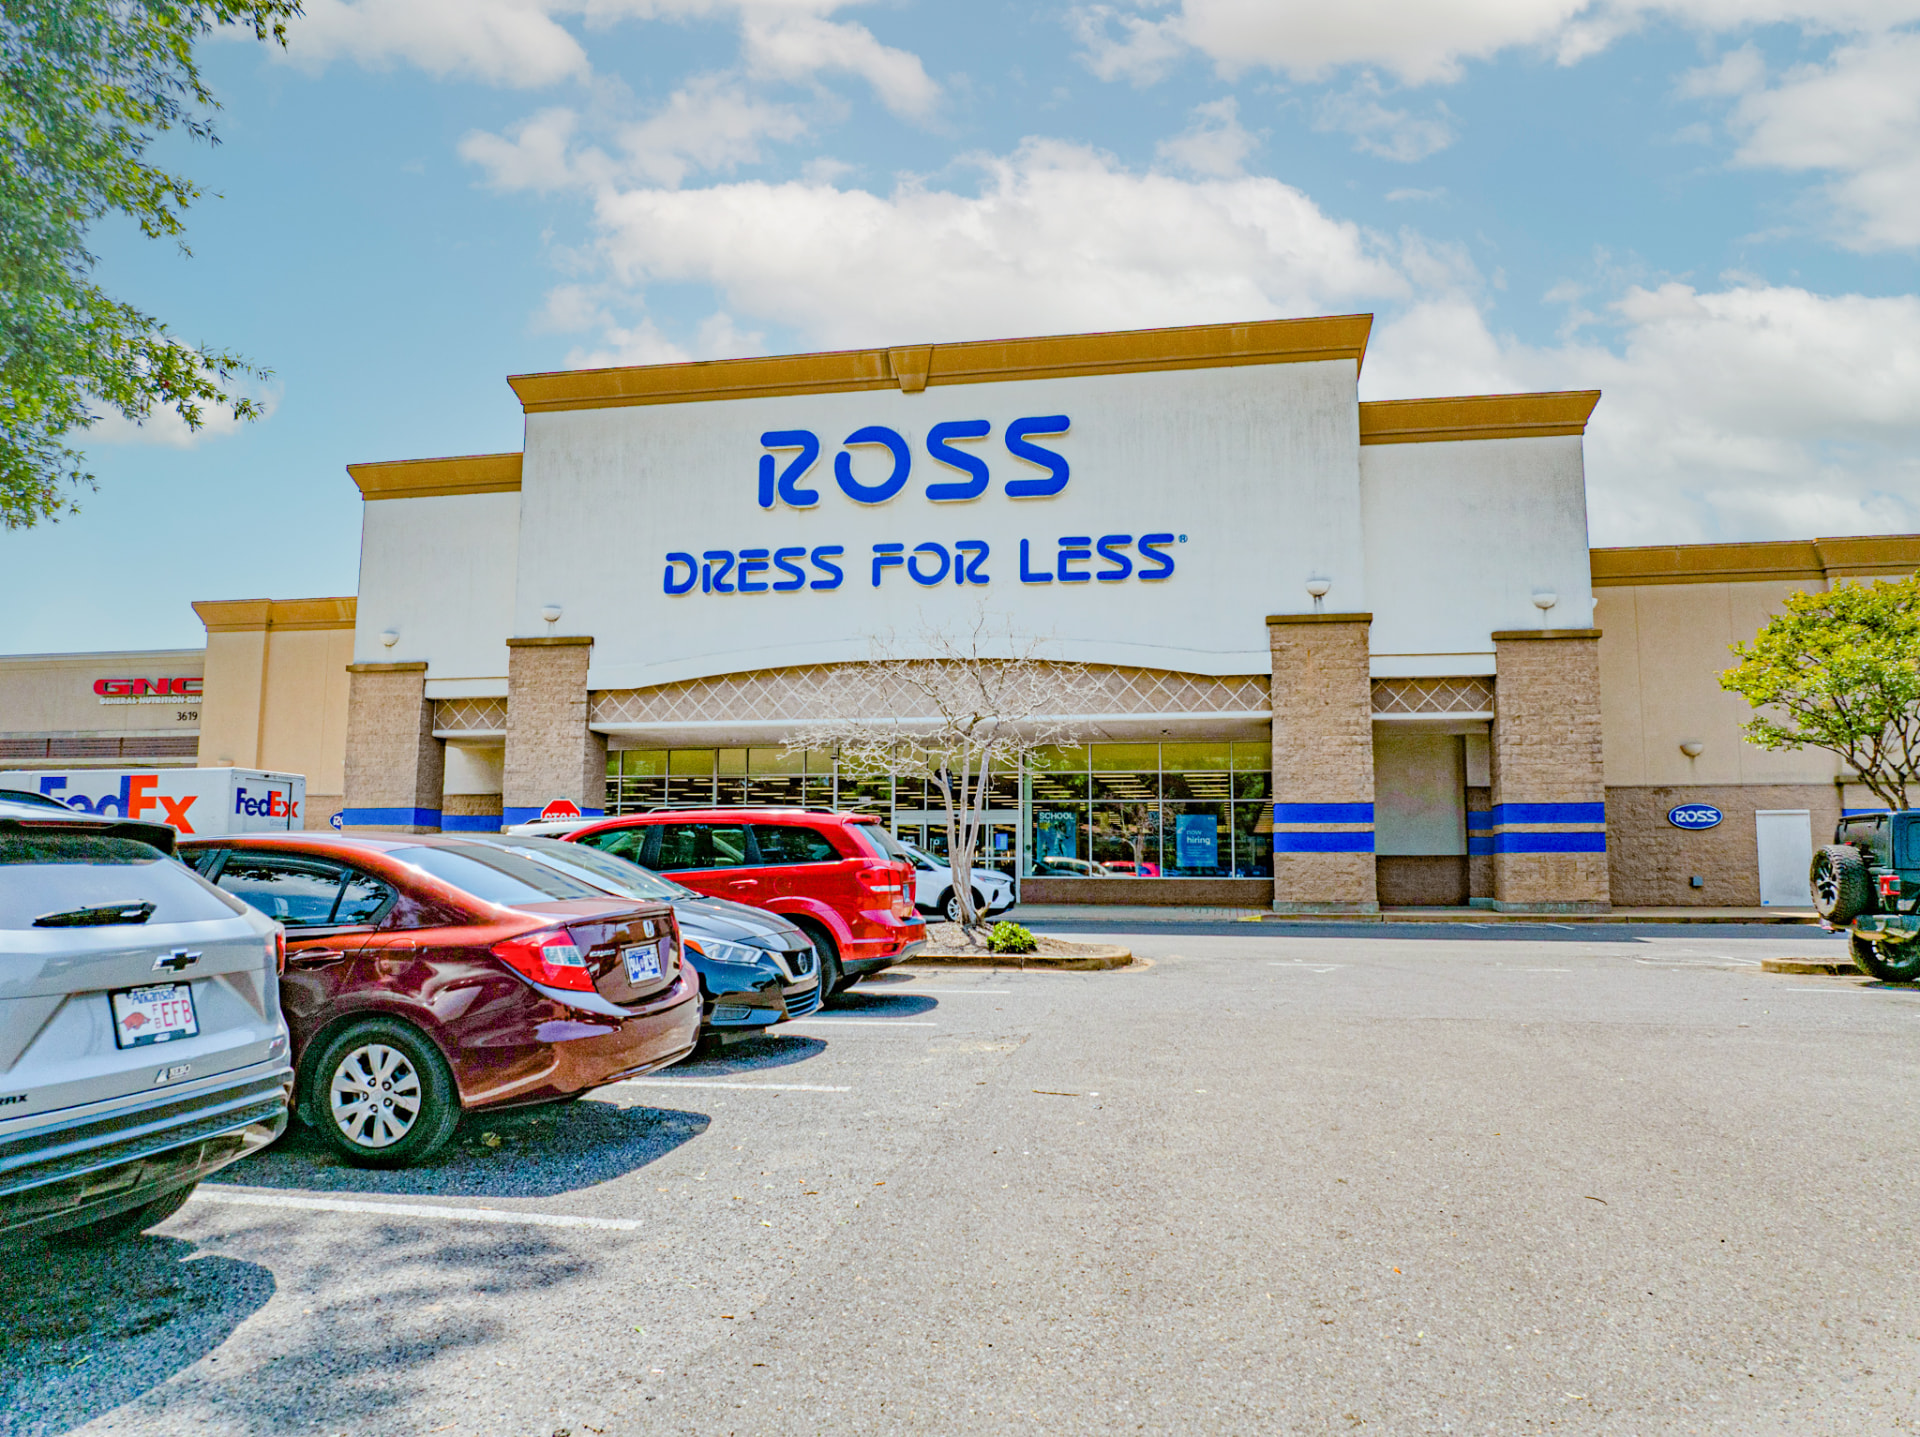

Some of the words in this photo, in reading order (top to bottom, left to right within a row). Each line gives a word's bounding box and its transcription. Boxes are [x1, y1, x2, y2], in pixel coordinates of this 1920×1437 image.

[758, 414, 1071, 510] ROSS
[663, 545, 845, 596] DRESS
[871, 540, 991, 588] FOR
[1019, 533, 1176, 584] LESS
[93, 677, 203, 696] GNC
[99, 697, 137, 705] GENERAL
[139, 696, 184, 704] NUTRITION
[176, 711, 198, 721] 3619
[40, 775, 198, 834] FedEx
[235, 787, 299, 819] FedEx
[1039, 811, 1075, 820] SCHOOL
[1675, 810, 1718, 823] ROSS
[1186, 836, 1211, 846] hiring
[161, 1000, 192, 1027] EFB
